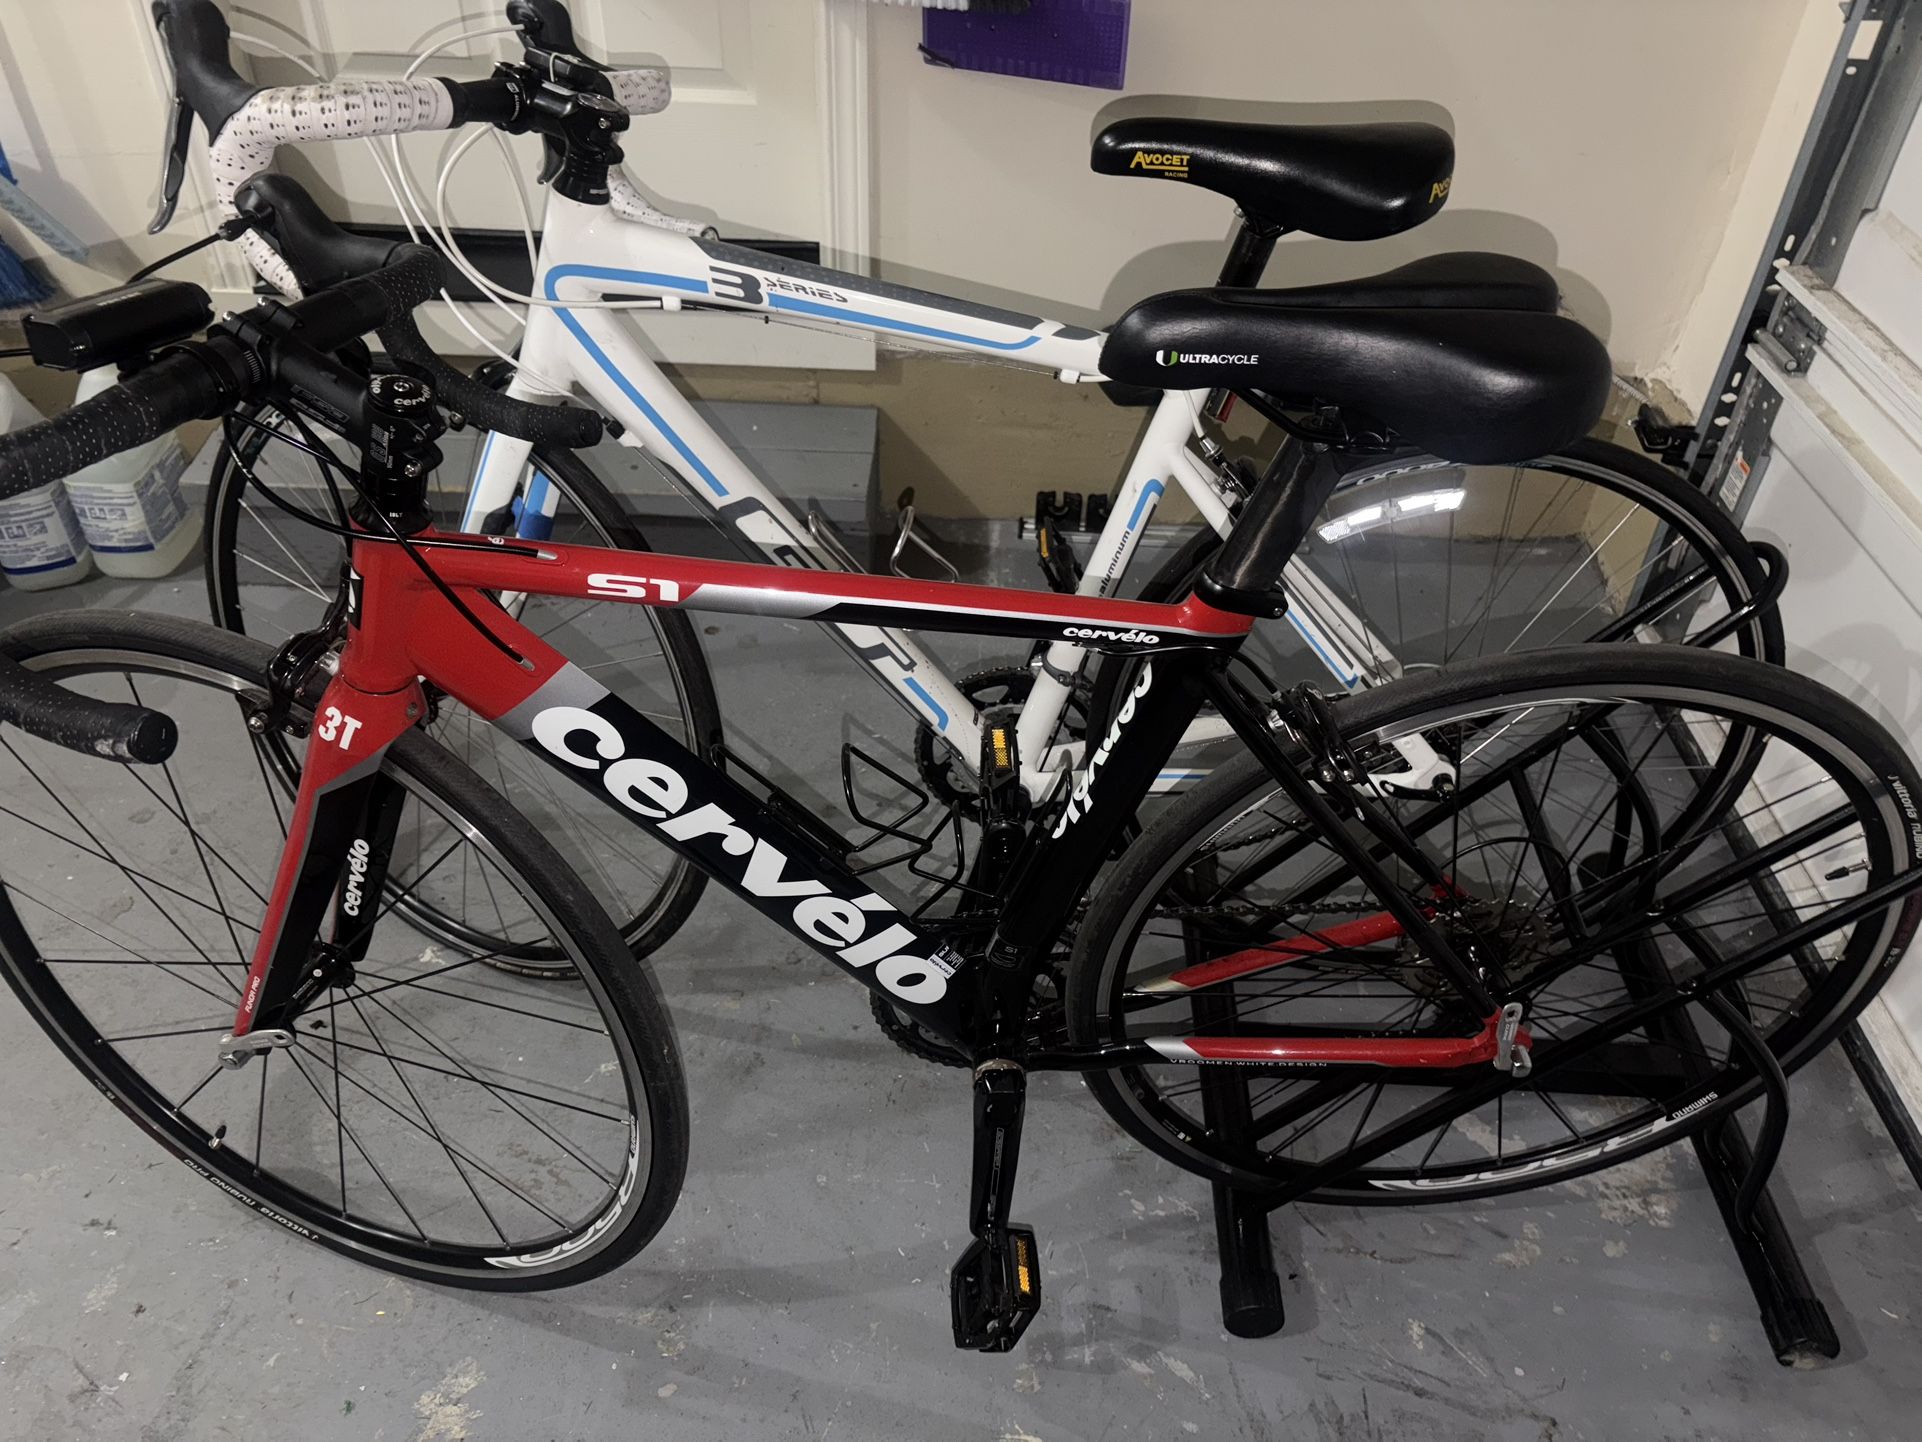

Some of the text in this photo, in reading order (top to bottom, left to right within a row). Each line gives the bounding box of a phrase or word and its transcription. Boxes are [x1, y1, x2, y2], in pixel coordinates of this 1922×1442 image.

[1130, 151, 1190, 171] AVOCET
[709, 266, 763, 305] 3
[1180, 353, 1259, 365] ULTRACYCLE
[587, 573, 679, 602] S1
[1063, 627, 1160, 644] cervélo
[318, 706, 363, 750] 3T
[532, 706, 947, 1004] cervélo
[344, 838, 370, 917] cervélo
[1671, 1091, 1718, 1119] SHIMANO
[183, 1159, 210, 1177] PRO
[210, 1177, 256, 1206] RUBINO
